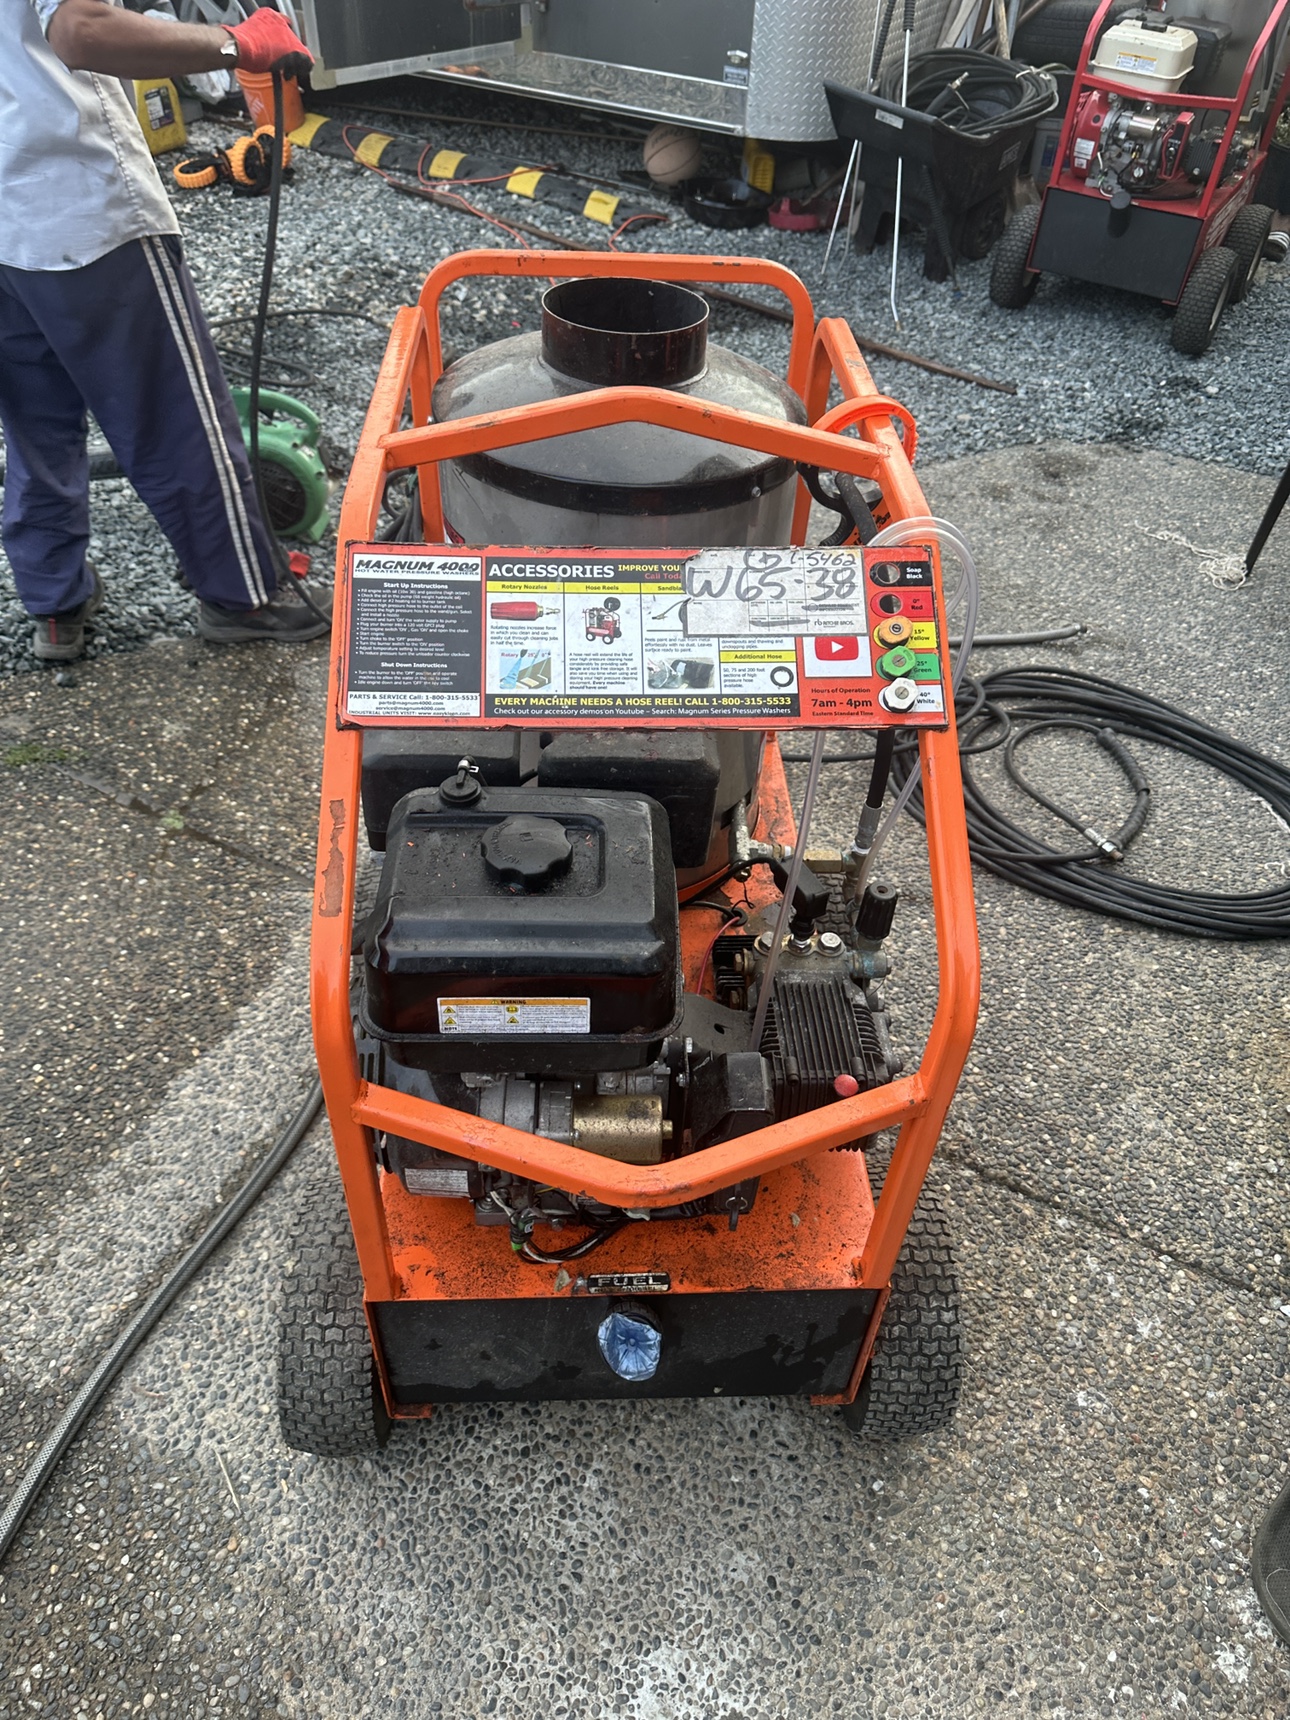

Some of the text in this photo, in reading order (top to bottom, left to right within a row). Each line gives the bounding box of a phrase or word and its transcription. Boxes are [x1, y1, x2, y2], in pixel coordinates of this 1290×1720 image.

[355, 560, 480, 572] MAGNUM 4000
[489, 564, 614, 578] ACCESSORIES
[812, 699, 836, 707] 7am
[847, 699, 872, 709] 4pm
[598, 1277, 661, 1286] FUEL
